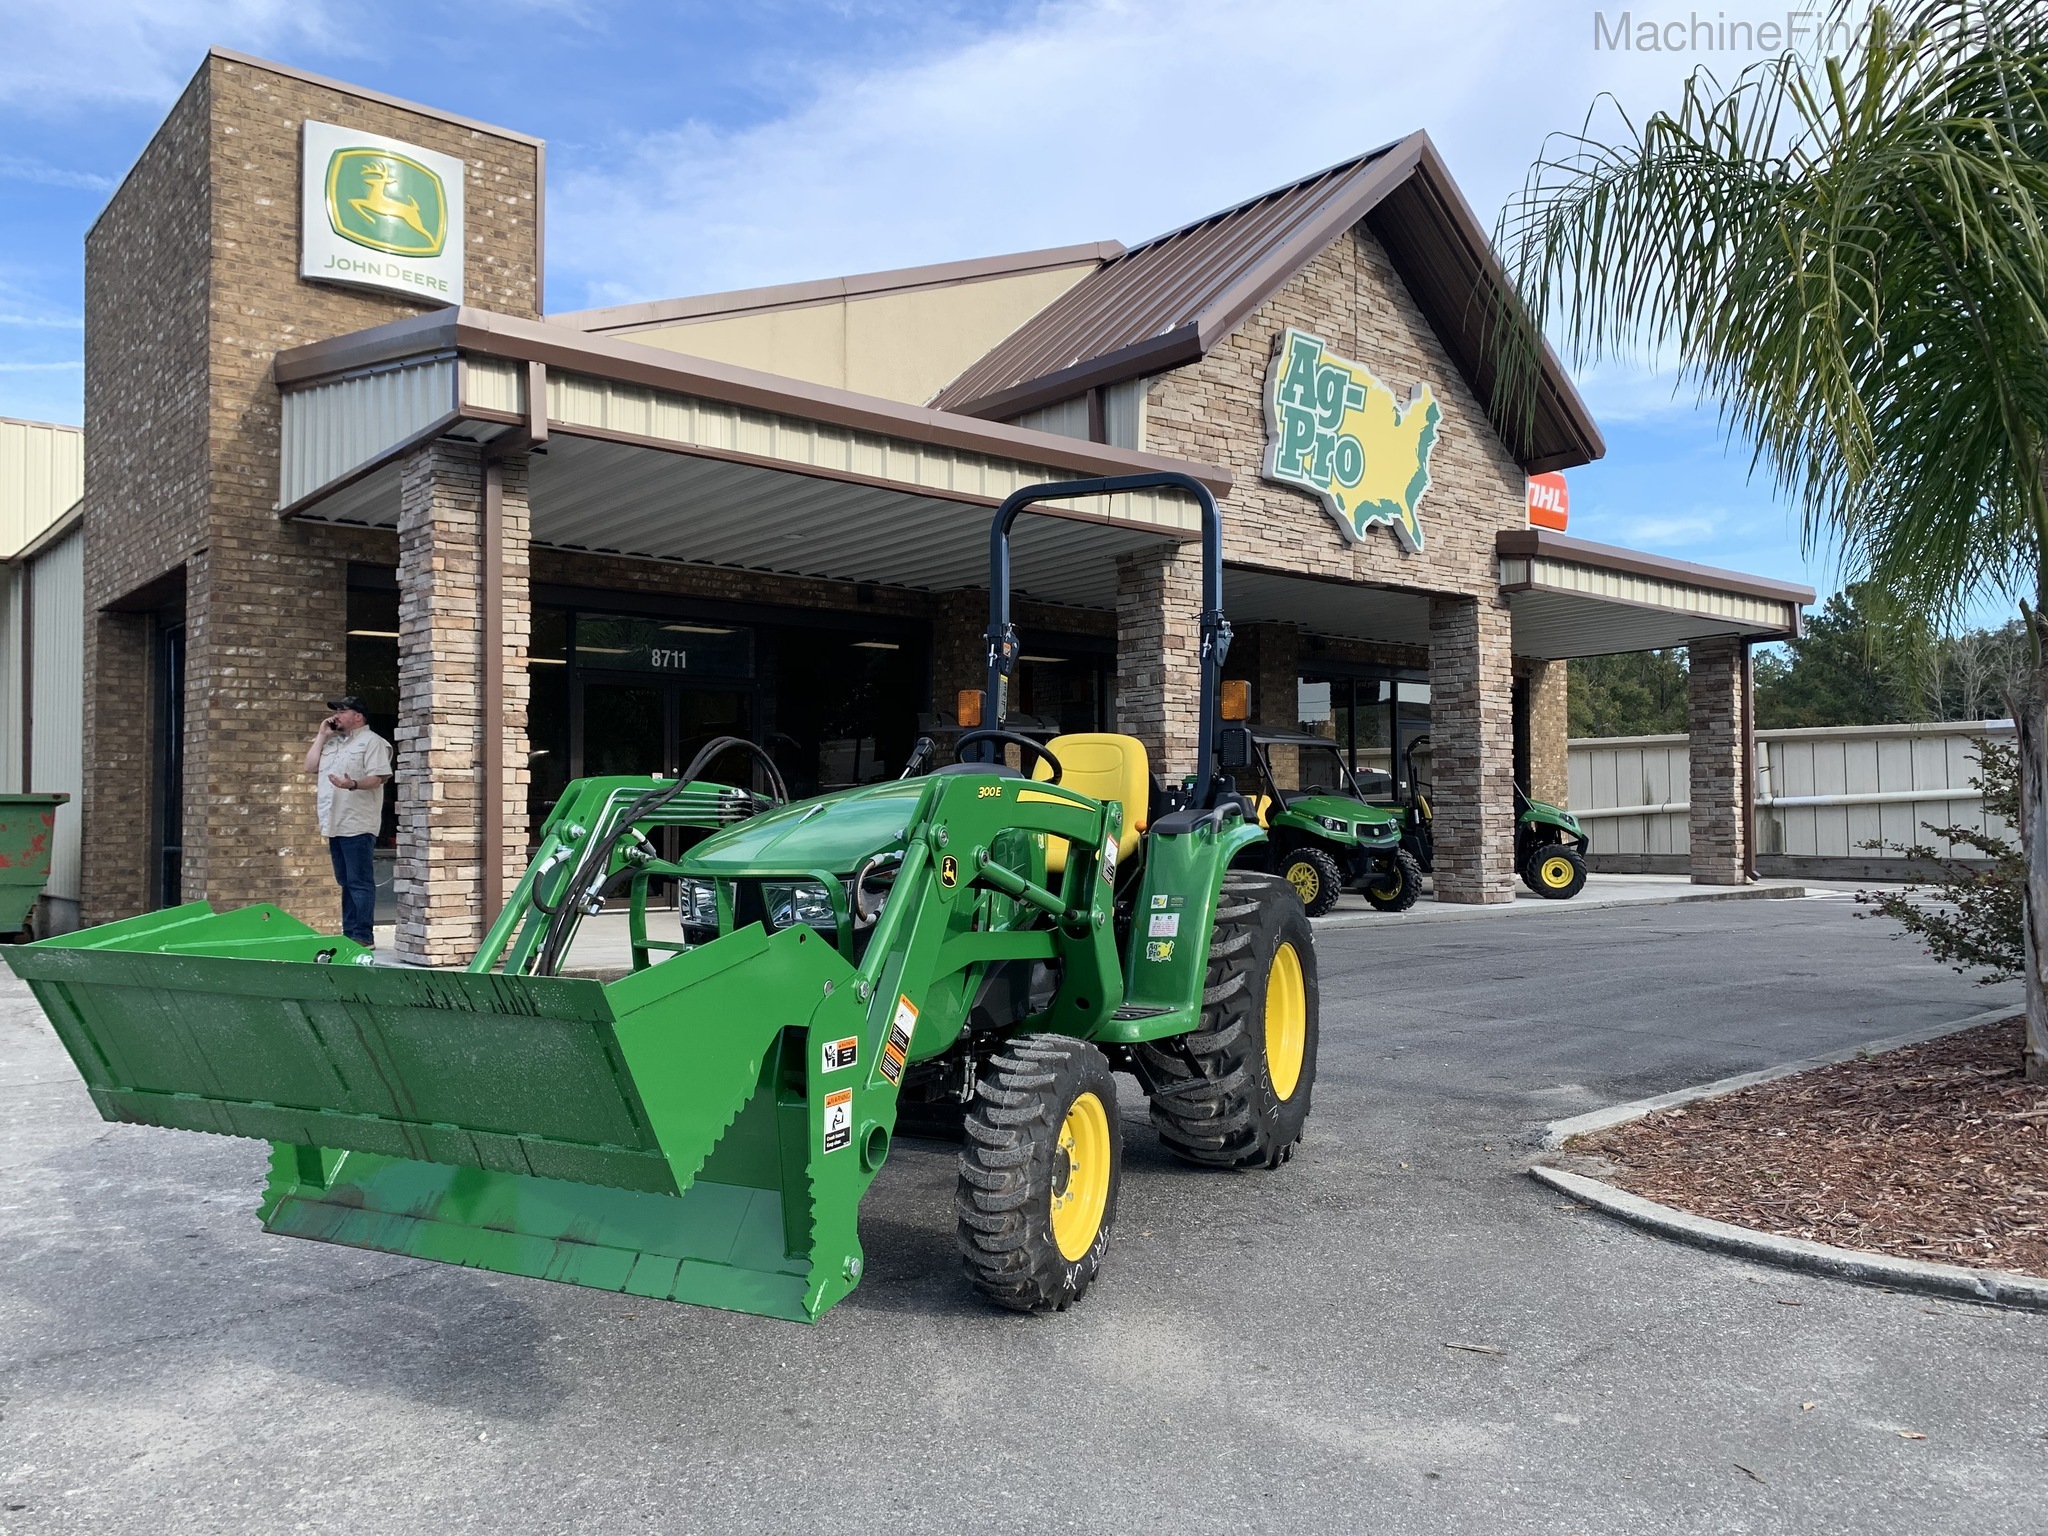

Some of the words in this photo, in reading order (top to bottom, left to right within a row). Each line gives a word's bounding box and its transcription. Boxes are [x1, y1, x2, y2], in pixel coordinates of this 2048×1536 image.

[324, 255, 381, 276] JOHN
[385, 263, 448, 292] DEERE
[1277, 333, 1367, 430] Ag-
[1276, 404, 1365, 488] Pro
[1529, 482, 1565, 513] IHL
[652, 649, 686, 668] 8711
[977, 786, 1002, 799] 300E
